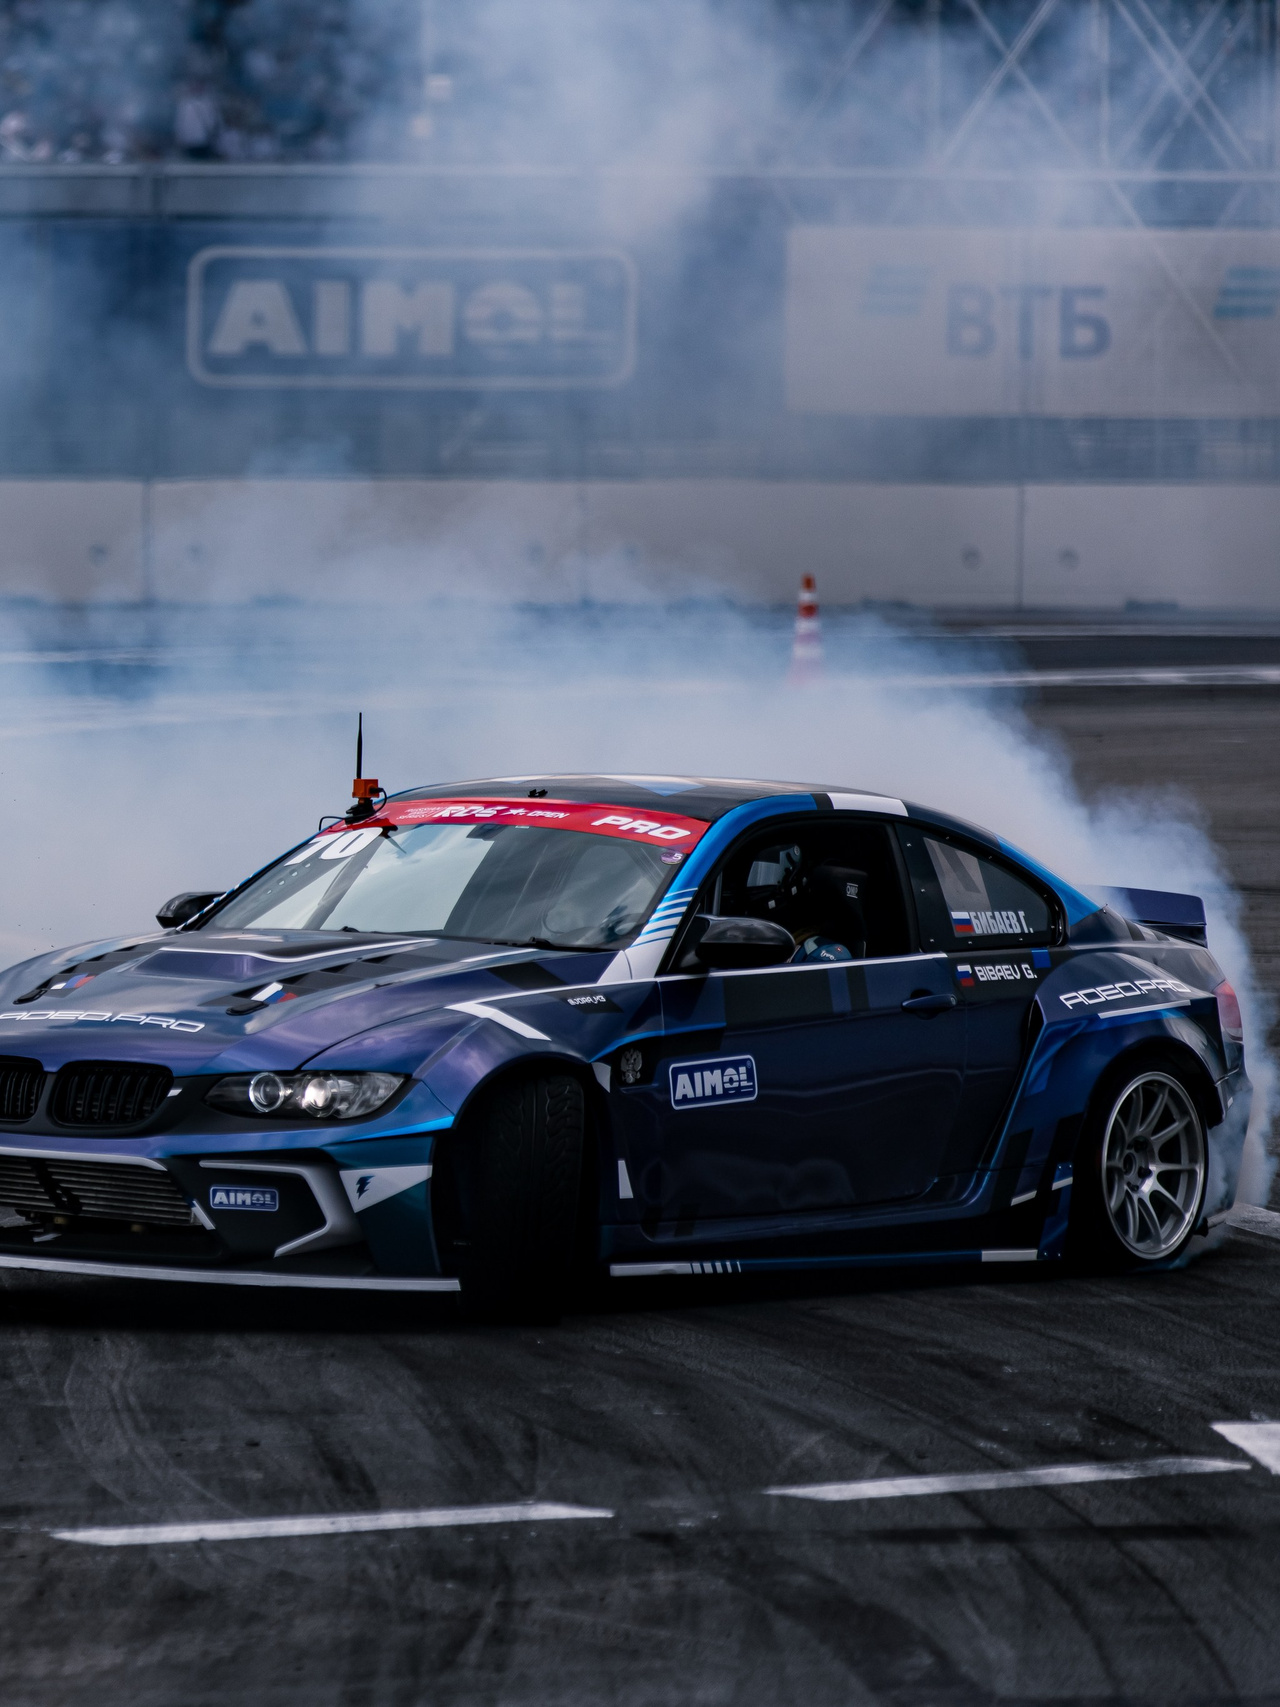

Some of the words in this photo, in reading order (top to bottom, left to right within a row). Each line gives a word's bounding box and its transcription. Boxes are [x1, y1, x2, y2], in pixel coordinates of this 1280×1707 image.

[207, 279, 615, 360] AIMOL
[945, 282, 1112, 361] ВТБ
[432, 805, 509, 818] RDS
[526, 810, 570, 819] OPEN
[590, 815, 692, 840] PRO
[284, 826, 384, 867] 70
[969, 911, 1022, 934] БИБАЕВ
[1018, 910, 1034, 934] Г.
[974, 964, 1022, 981] BIBAEV
[1021, 963, 1038, 979] G.
[1058, 978, 1193, 1010] ADEO.PRO
[674, 1066, 754, 1100] AIMOL
[213, 1191, 276, 1206] AIMOL
